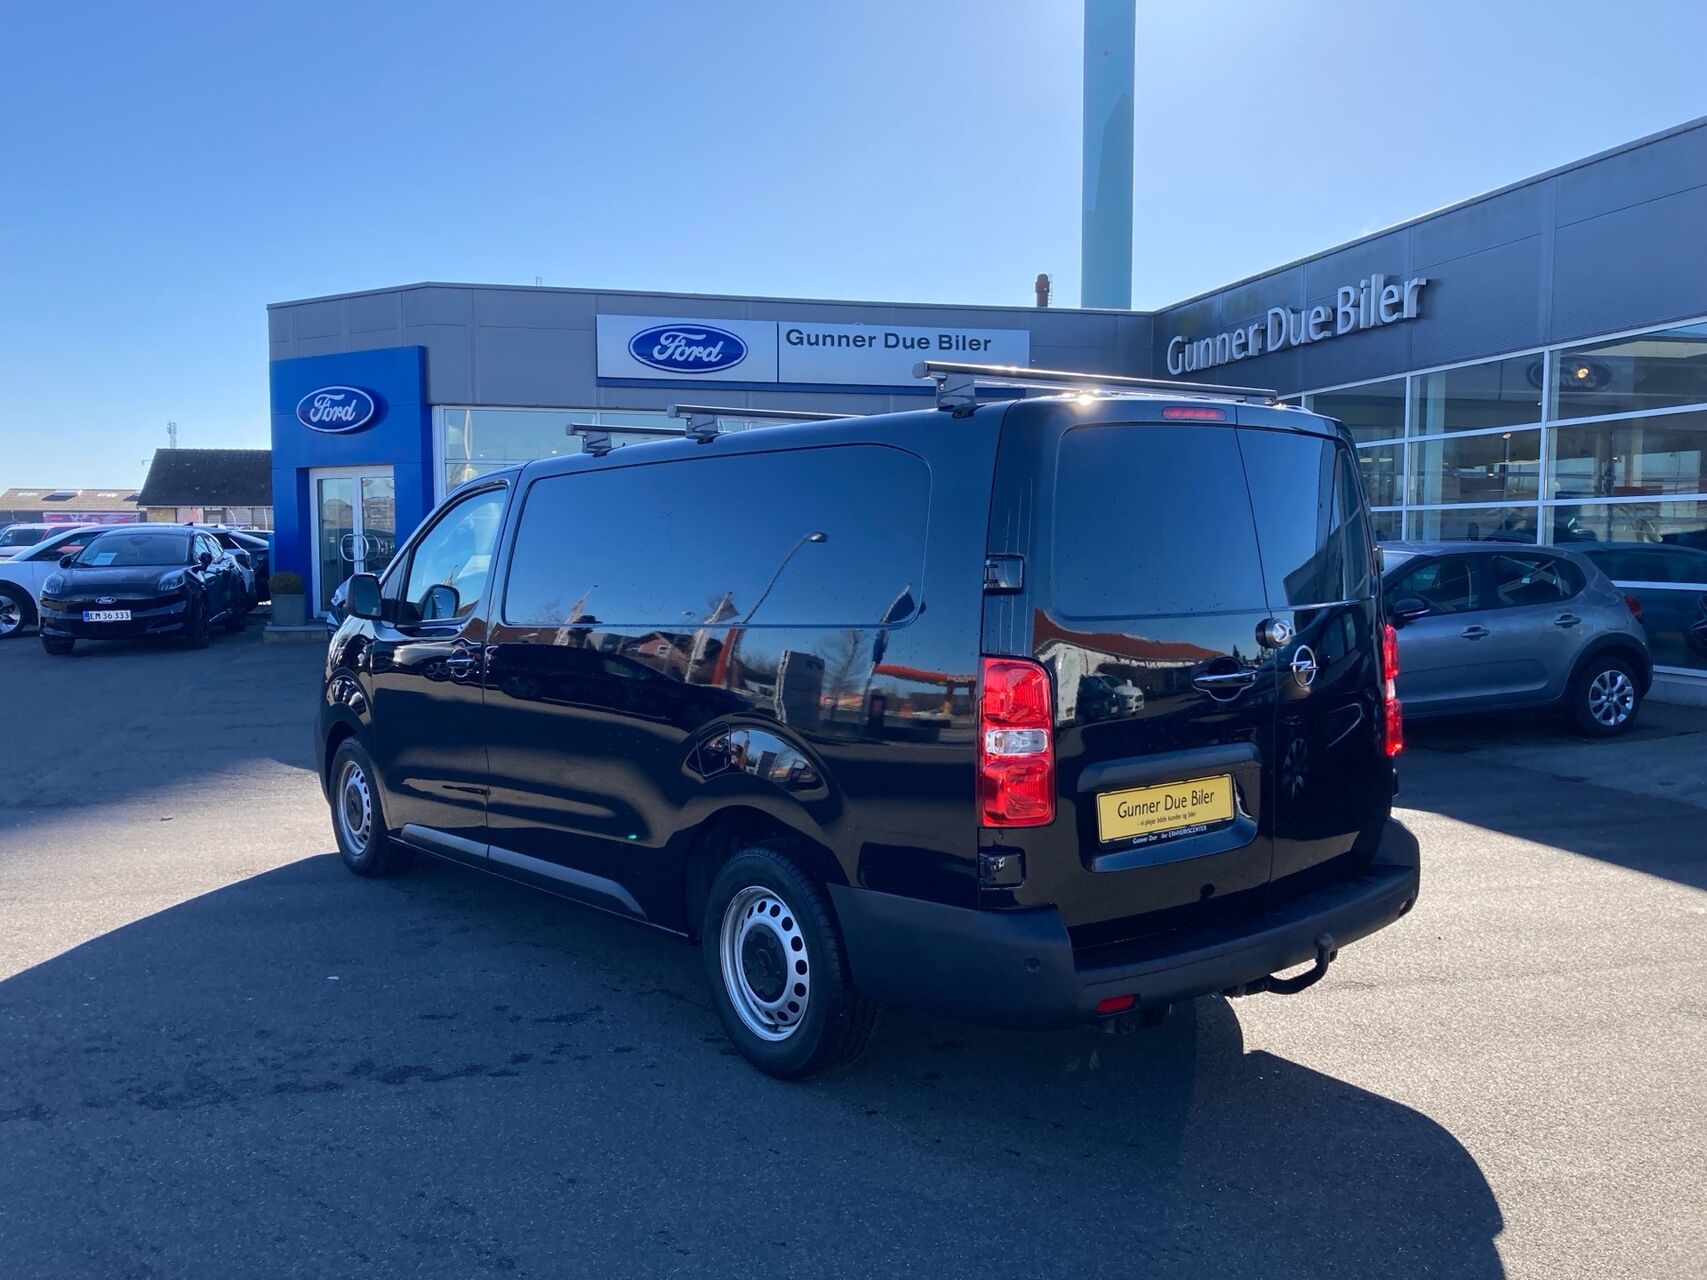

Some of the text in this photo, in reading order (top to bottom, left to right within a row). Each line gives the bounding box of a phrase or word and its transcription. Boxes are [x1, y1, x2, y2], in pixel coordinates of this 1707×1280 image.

[785, 328, 991, 351] Gunner Due Biler
[1166, 273, 1429, 376] Gunner Due Biler
[652, 331, 724, 363] Ford
[309, 393, 357, 423] Ford
[103, 612, 113, 620] 36
[114, 611, 130, 620] 333
[1117, 788, 1215, 818] Gunner Due Biler
